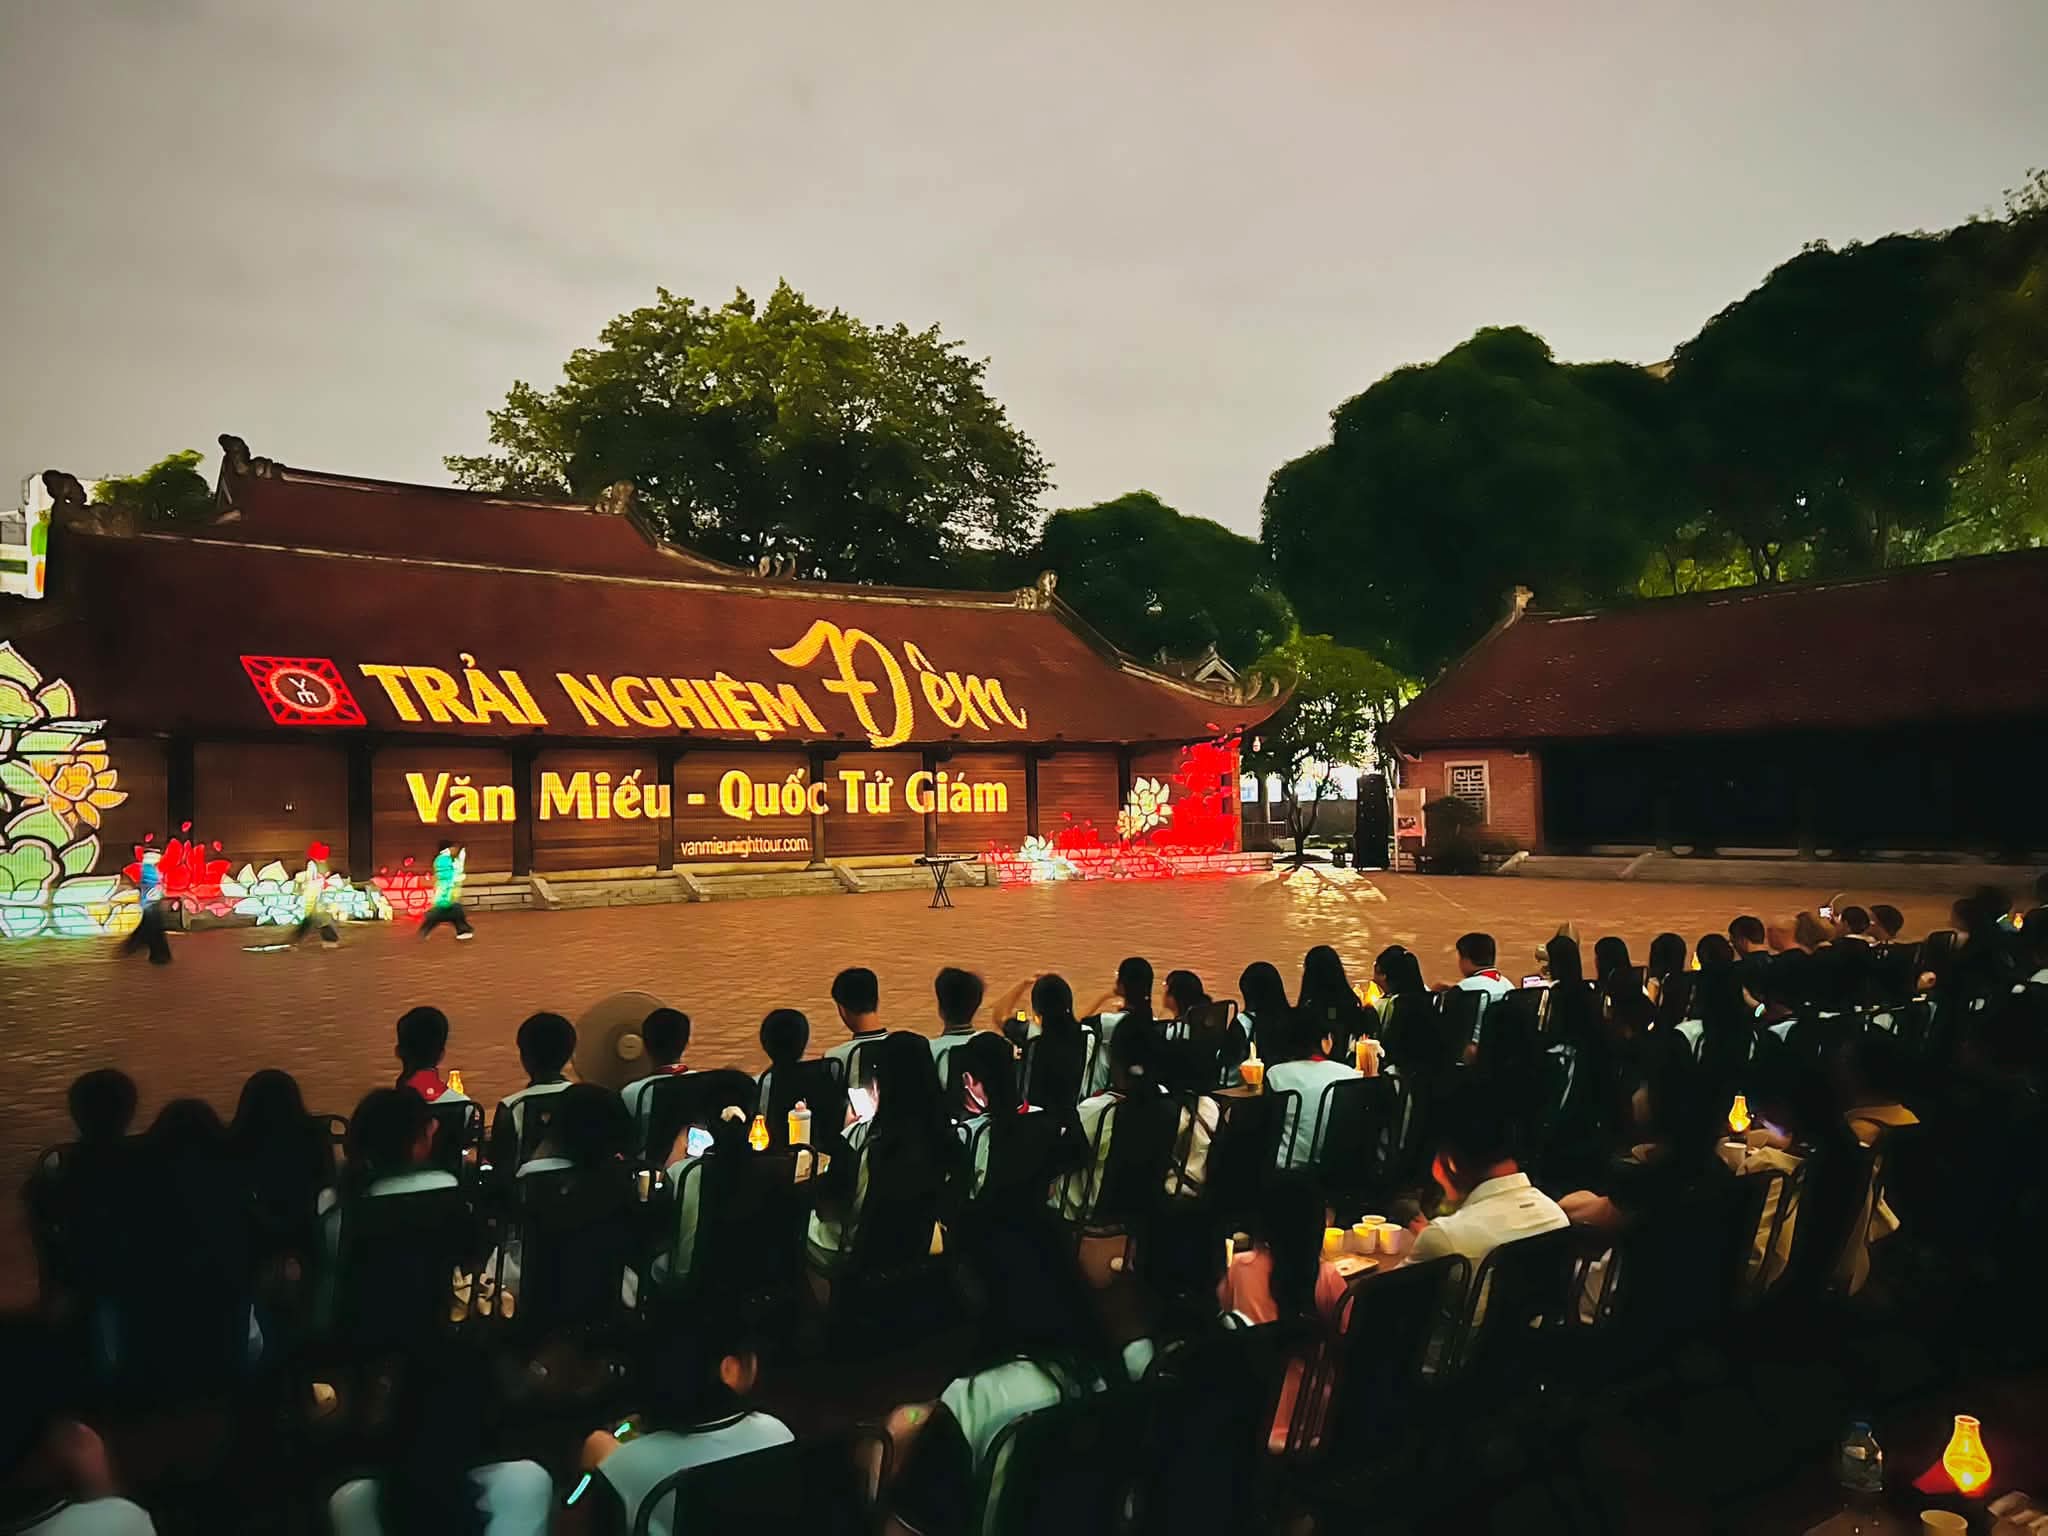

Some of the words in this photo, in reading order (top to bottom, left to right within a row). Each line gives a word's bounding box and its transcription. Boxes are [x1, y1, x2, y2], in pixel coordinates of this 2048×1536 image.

[358, 653, 549, 724] TRẢI
[557, 671, 827, 742] NGHIỆM
[769, 619, 1028, 749] Đêm
[406, 772, 517, 824] Văn
[539, 769, 672, 821] Miếu
[719, 768, 829, 822] Quốc
[838, 769, 894, 815] Tử
[905, 771, 1008, 814] Giám
[680, 835, 809, 858] vanmieunighttour.com
